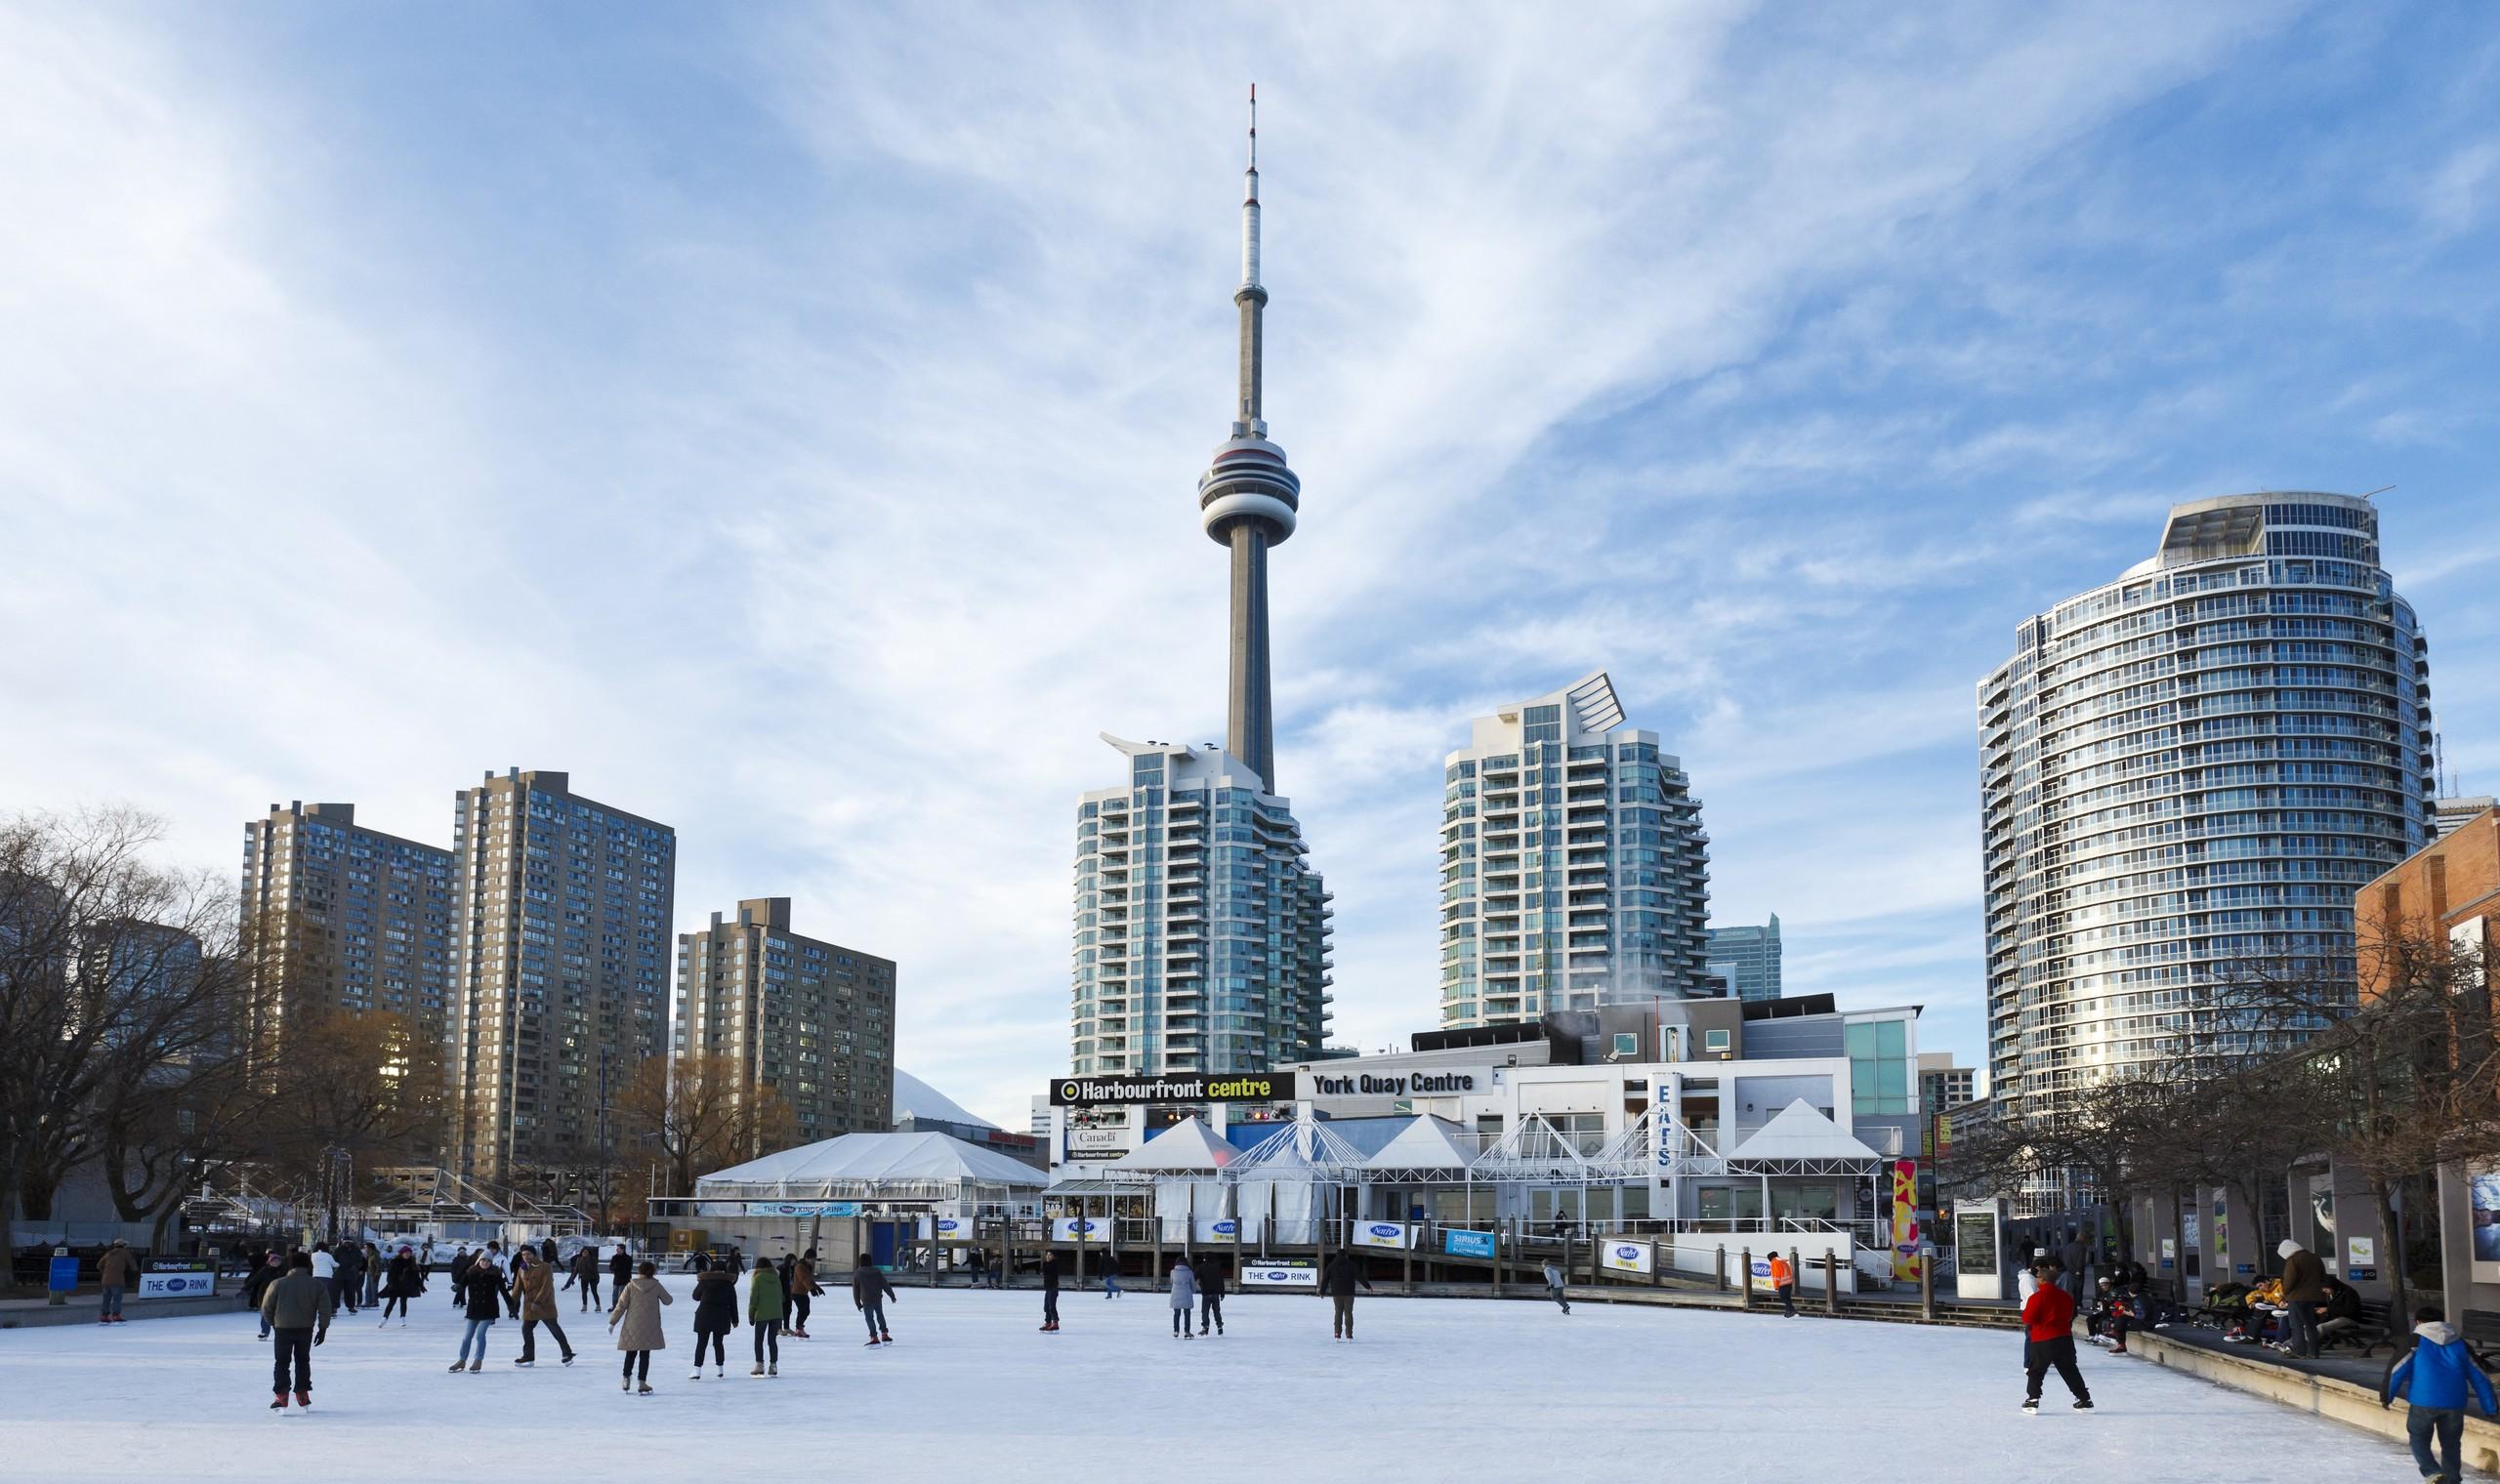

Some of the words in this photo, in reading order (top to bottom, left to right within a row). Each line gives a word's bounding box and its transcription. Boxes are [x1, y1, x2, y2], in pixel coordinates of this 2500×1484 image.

[1082, 1079, 1204, 1100] Harbourfront
[1208, 1078, 1271, 1097] centre
[1313, 1075, 1354, 1094] York
[1360, 1073, 1406, 1095] Quay
[1411, 1072, 1474, 1092] Centre
[1658, 1085, 1671, 1167] EATS
[1079, 1132, 1116, 1142] Canada
[1454, 1234, 1481, 1244] SIRIUS
[1290, 1272, 1311, 1281] RINK
[146, 1281, 164, 1291] THE
[188, 1279, 209, 1290] RINK
